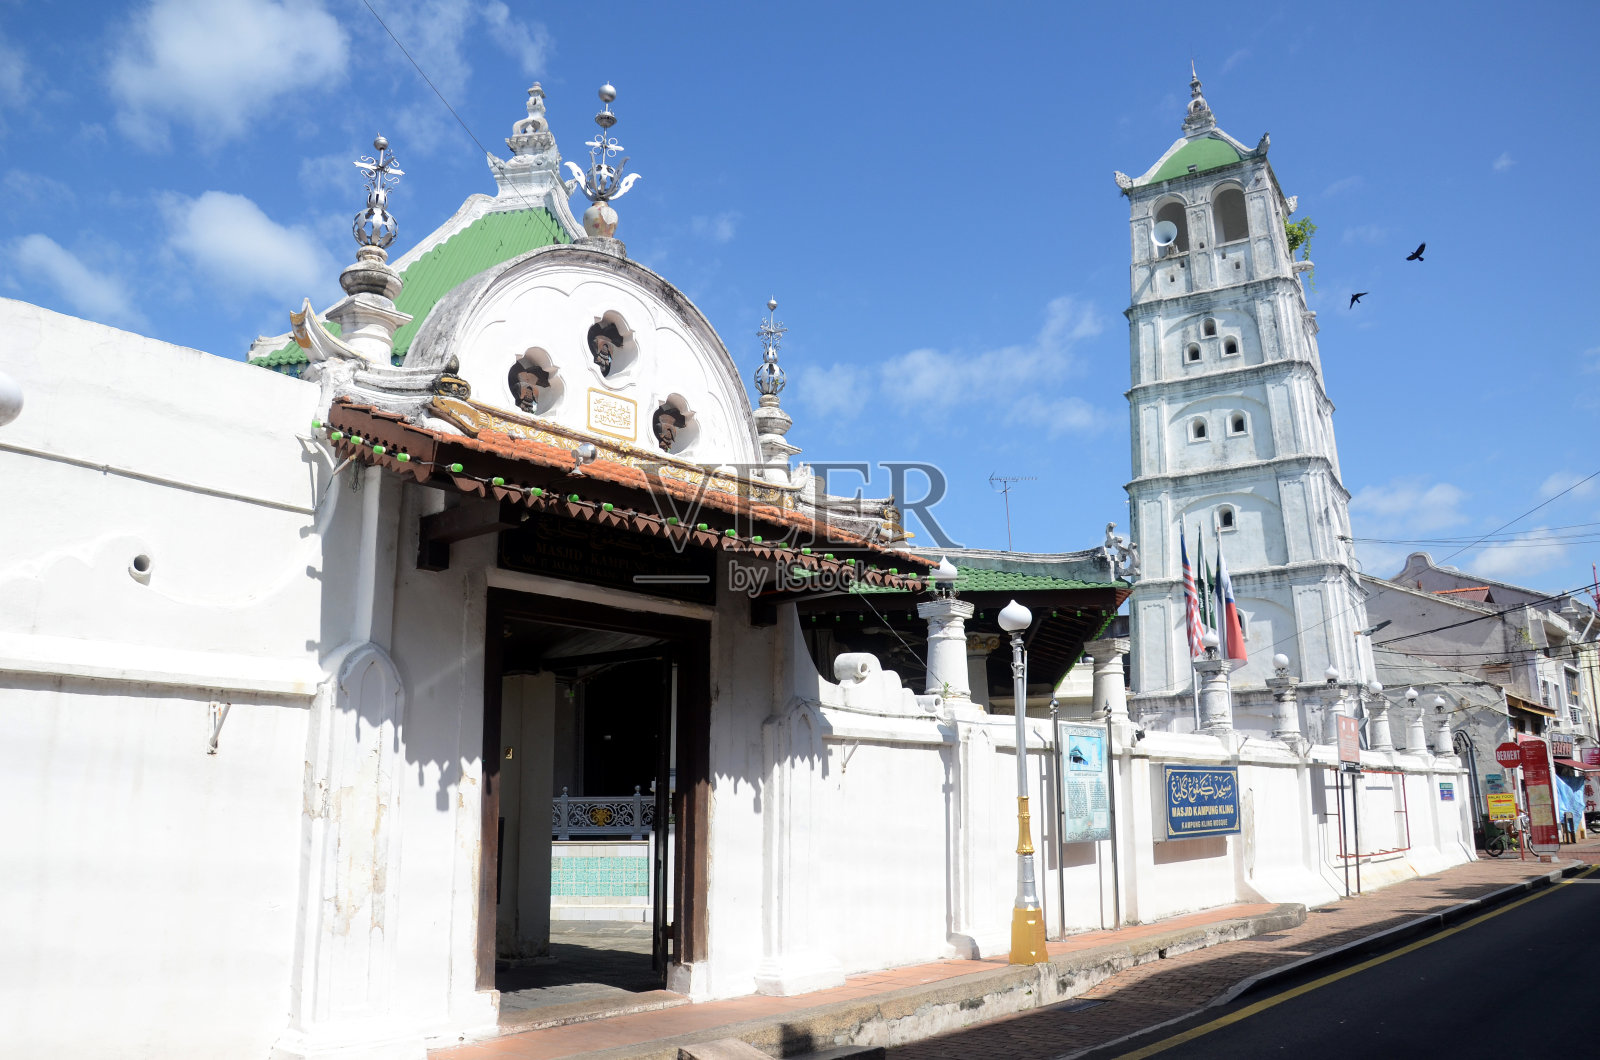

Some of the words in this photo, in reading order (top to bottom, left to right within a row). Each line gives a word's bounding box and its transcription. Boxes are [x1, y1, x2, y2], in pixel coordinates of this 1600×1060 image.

[1172, 807, 1193, 817] MASJID
[1194, 806, 1218, 816] KAMPUNG
[1219, 805, 1234, 814] KLING
